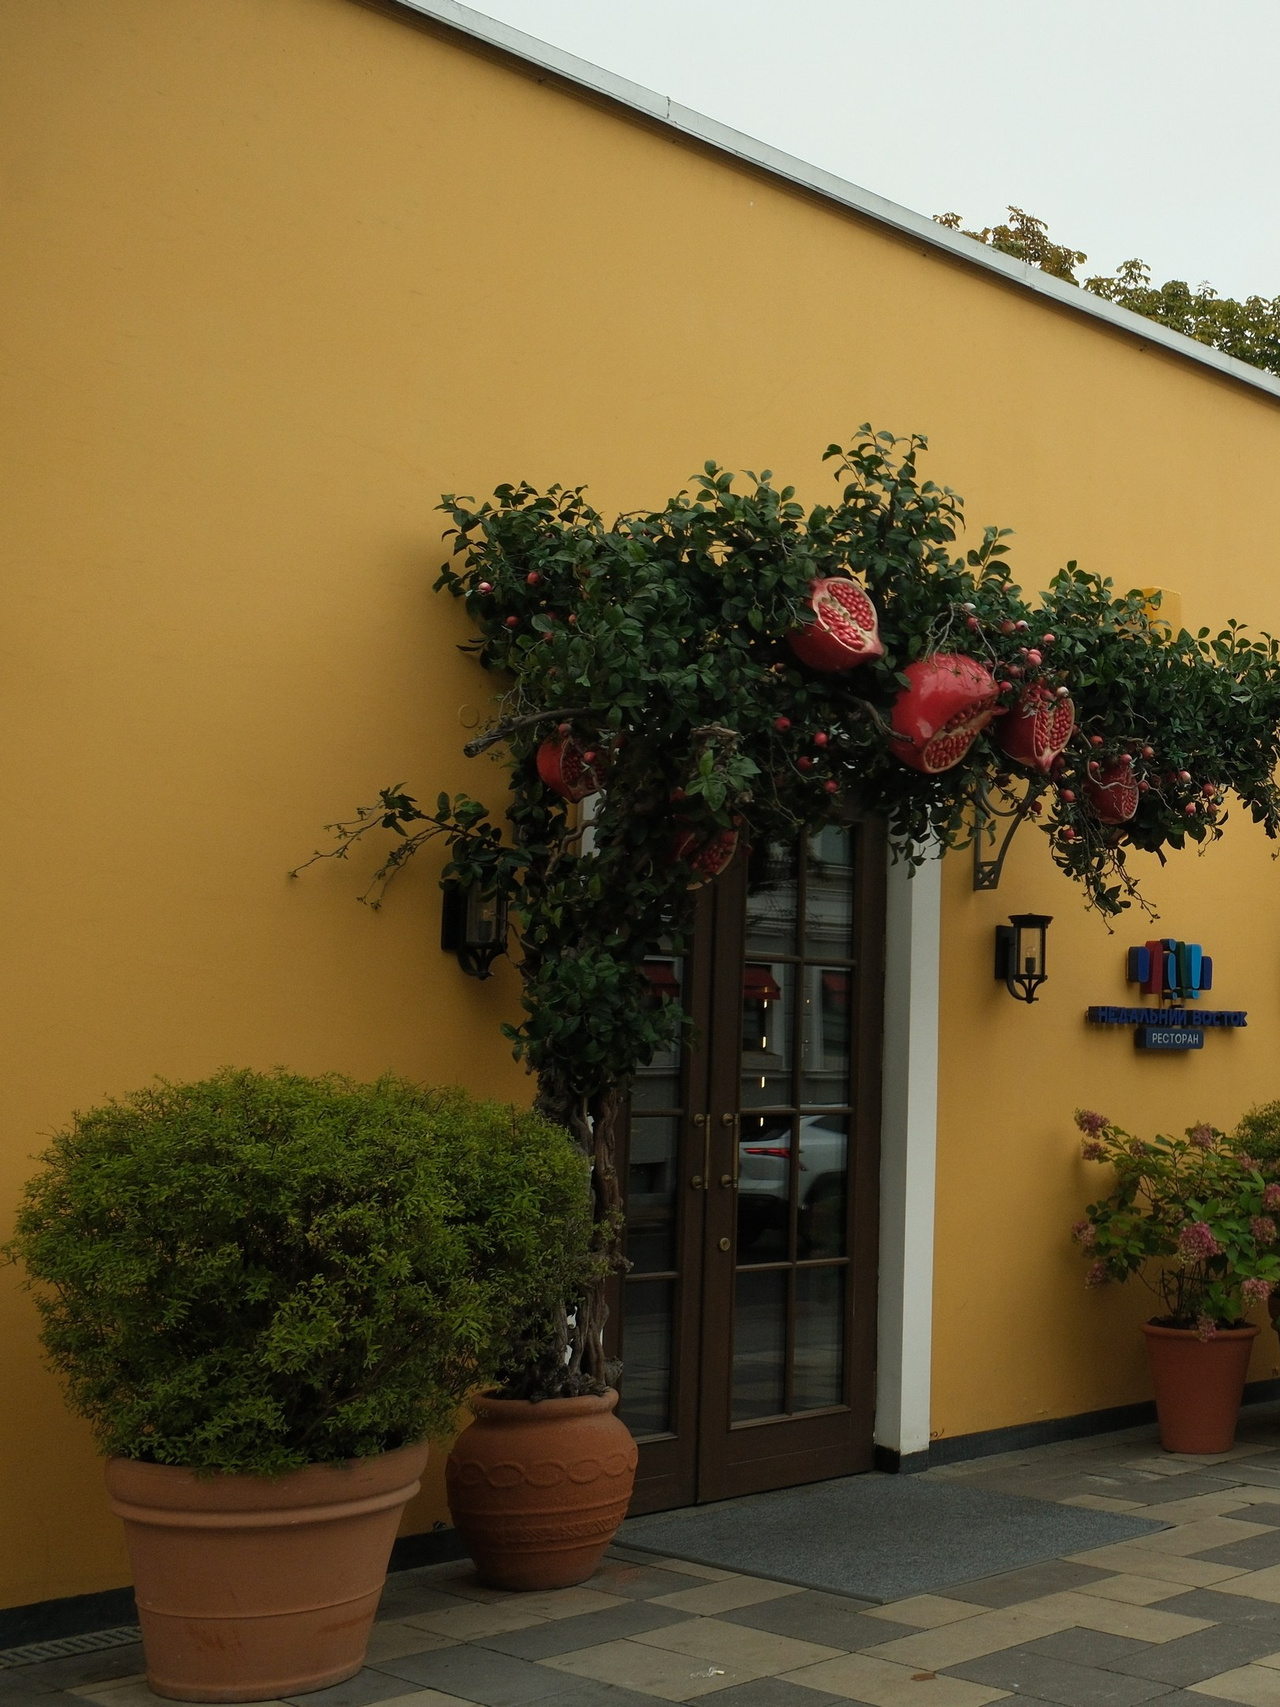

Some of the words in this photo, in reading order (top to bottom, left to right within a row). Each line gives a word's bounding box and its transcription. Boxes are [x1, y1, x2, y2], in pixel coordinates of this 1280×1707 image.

[1098, 1004, 1187, 1025] НЕДАЛЬНИЙ
[1193, 1010, 1248, 1026] ВОСТОК
[1152, 1033, 1199, 1044] РЕСТОРАН
